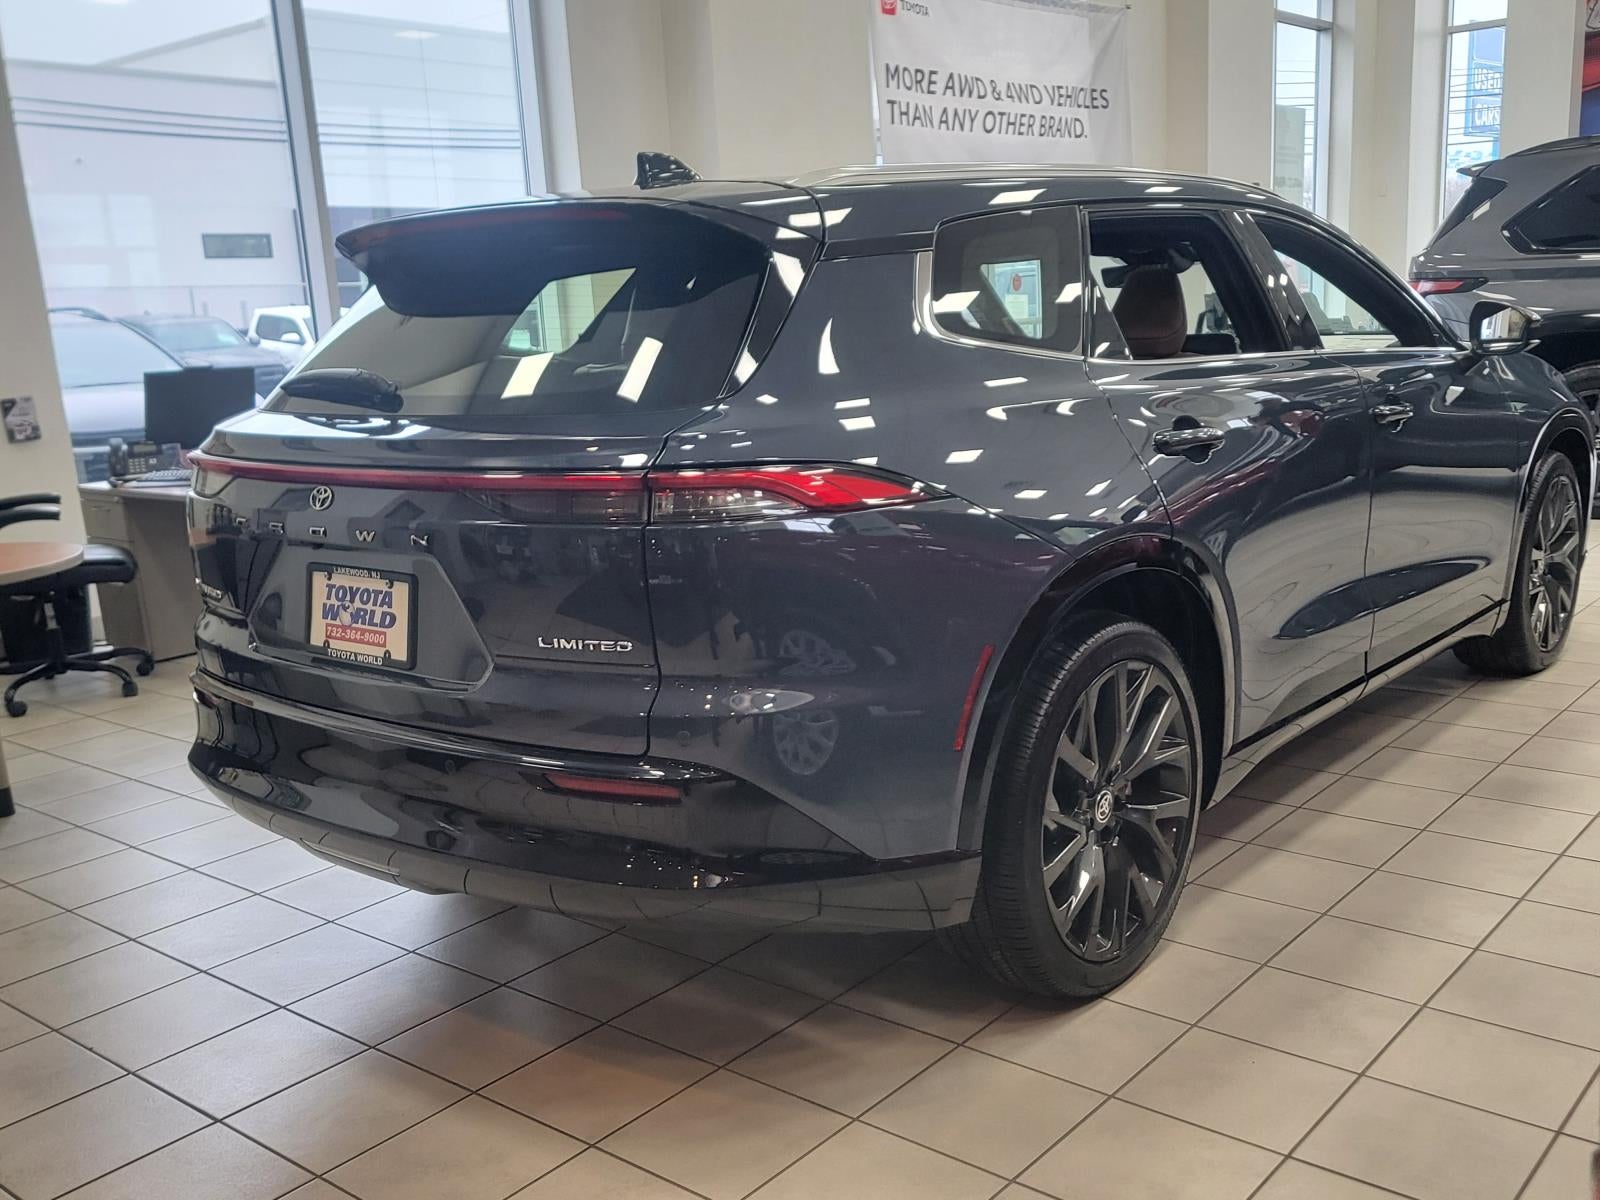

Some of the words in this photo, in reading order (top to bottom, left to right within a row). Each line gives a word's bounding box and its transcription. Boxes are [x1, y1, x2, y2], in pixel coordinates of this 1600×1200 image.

[885, 63, 939, 95] MORE
[942, 72, 987, 99] AWD
[990, 79, 1004, 101] &
[1006, 81, 1043, 104] 4WD
[1044, 84, 1110, 110] VEHICLES
[1474, 67, 1503, 91] USED
[886, 99, 935, 129] THAN
[938, 106, 980, 132] ANY
[982, 110, 1036, 137] OTHER
[1039, 115, 1088, 139] BRAND.
[1474, 103, 1501, 127] CARS
[325, 583, 393, 609] TOYOTA
[322, 602, 397, 629] WRLD
[326, 626, 385, 644] 732-364-9000
[537, 636, 633, 652] LIMITED
[327, 648, 355, 661] TOYOTA
[357, 652, 383, 665] WORLD
